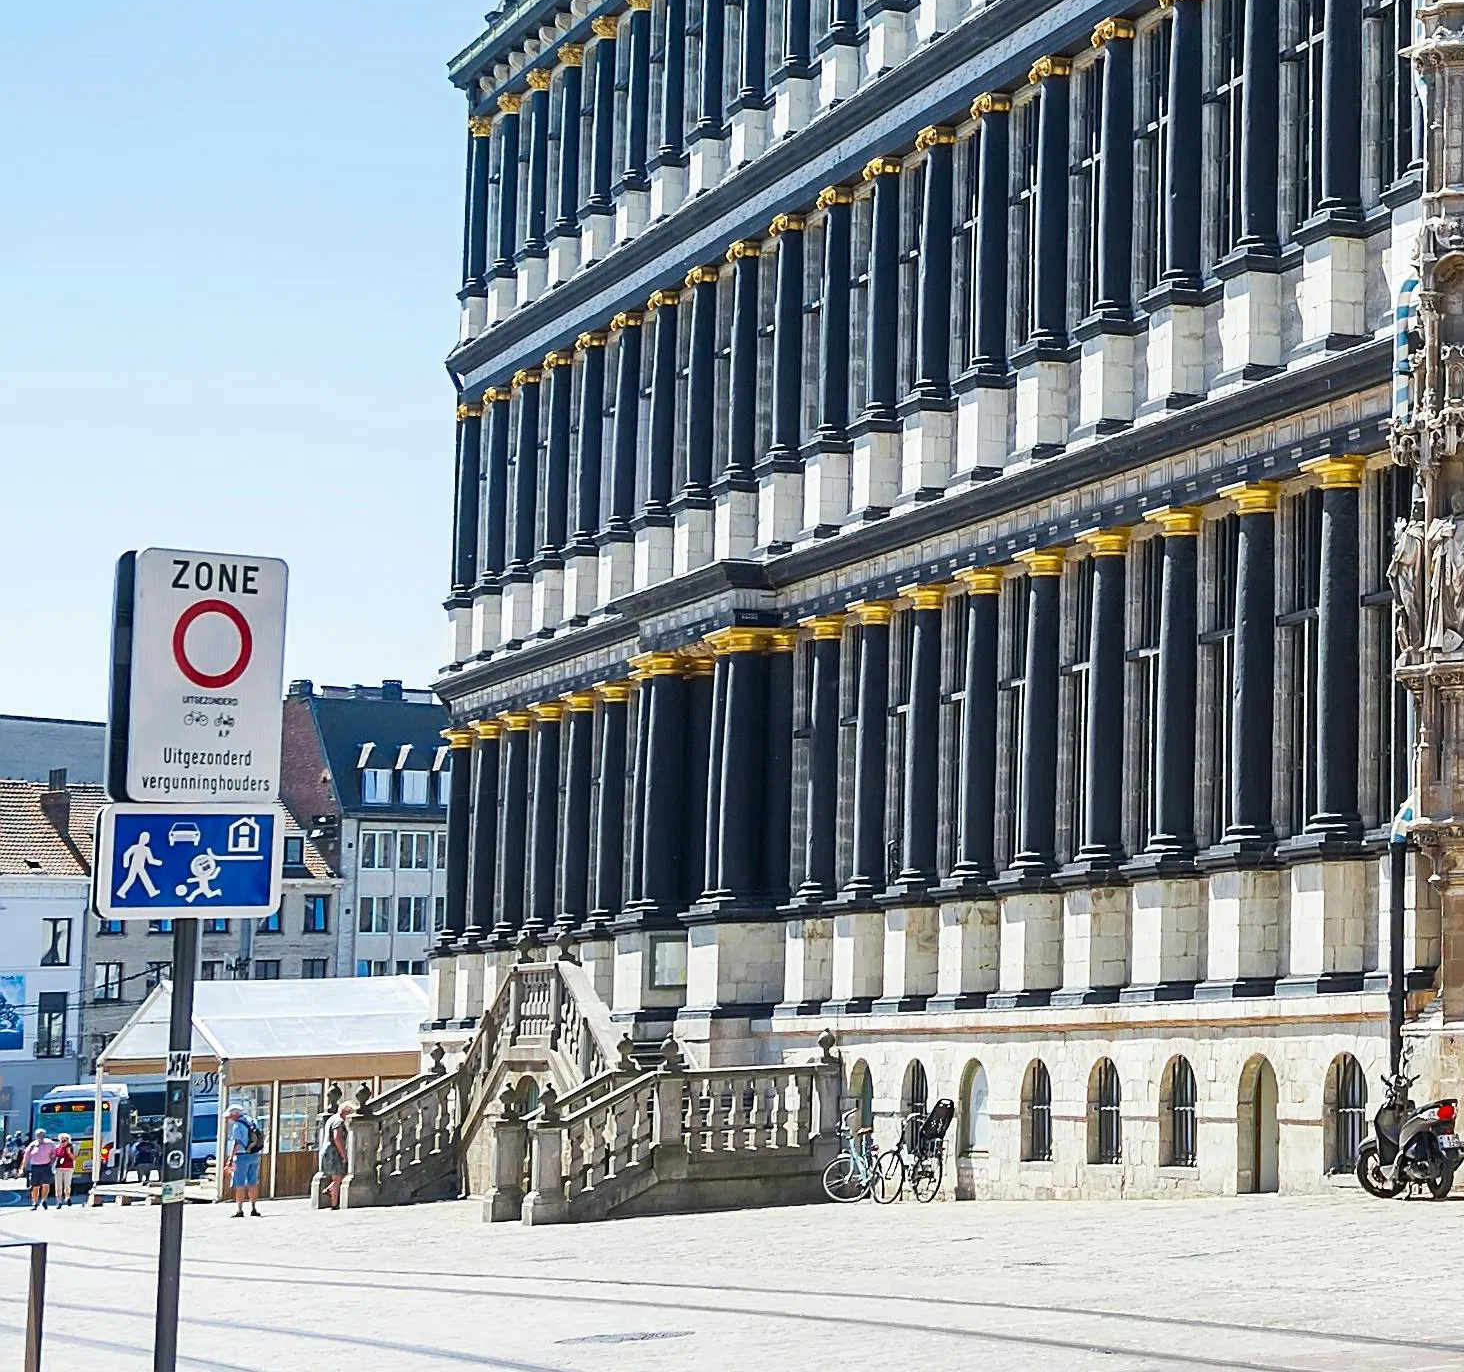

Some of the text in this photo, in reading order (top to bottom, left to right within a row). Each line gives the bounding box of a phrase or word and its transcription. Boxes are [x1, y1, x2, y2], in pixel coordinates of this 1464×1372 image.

[171, 560, 259, 595] ZONE
[163, 747, 252, 769] Uitgezonderd
[141, 774, 270, 795] vergunninghouders
